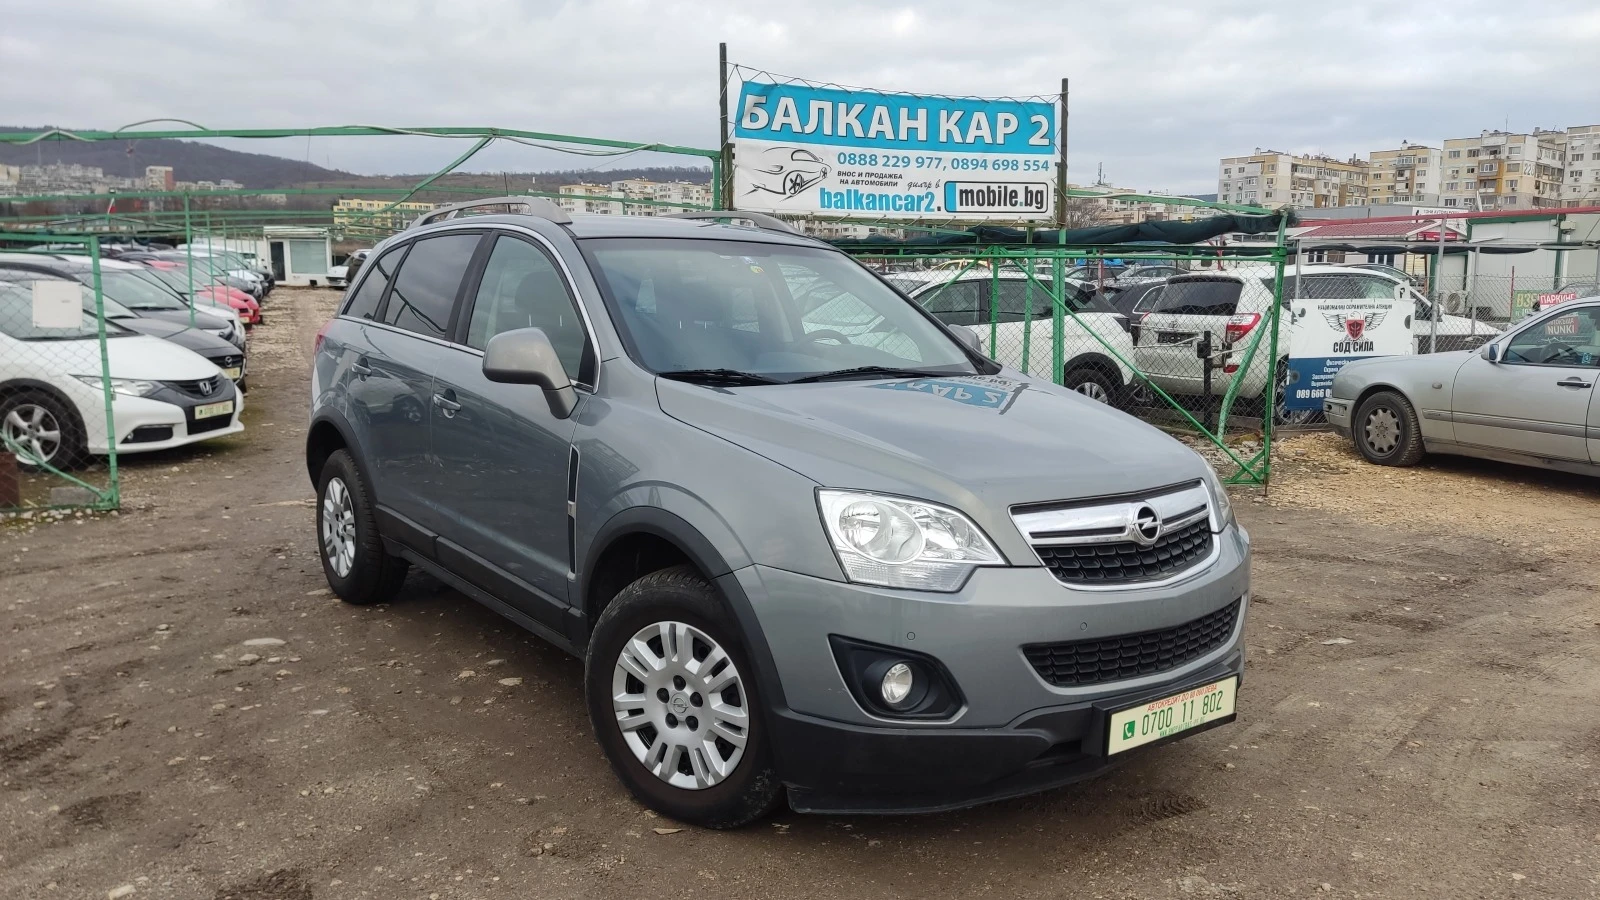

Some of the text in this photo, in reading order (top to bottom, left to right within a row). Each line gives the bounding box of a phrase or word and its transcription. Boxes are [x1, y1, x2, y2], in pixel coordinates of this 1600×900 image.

[741, 94, 1050, 147] БАЛКАН КАР 2
[837, 152, 1050, 172] 0888 229 977, 0894 698 554
[864, 172, 903, 180] ПРОДАЖБА
[851, 179, 899, 187] АВТОМОБИЛИ
[960, 185, 1045, 210] mobile.bg
[1547, 323, 1575, 335] NUNKI
[1333, 341, 1374, 354] СОД СИЛА
[1296, 389, 1310, 399] 089
[1311, 389, 1325, 398] 666
[1142, 706, 1173, 736] 0700
[1182, 699, 1195, 723] 11
[1202, 690, 1224, 716] 802
